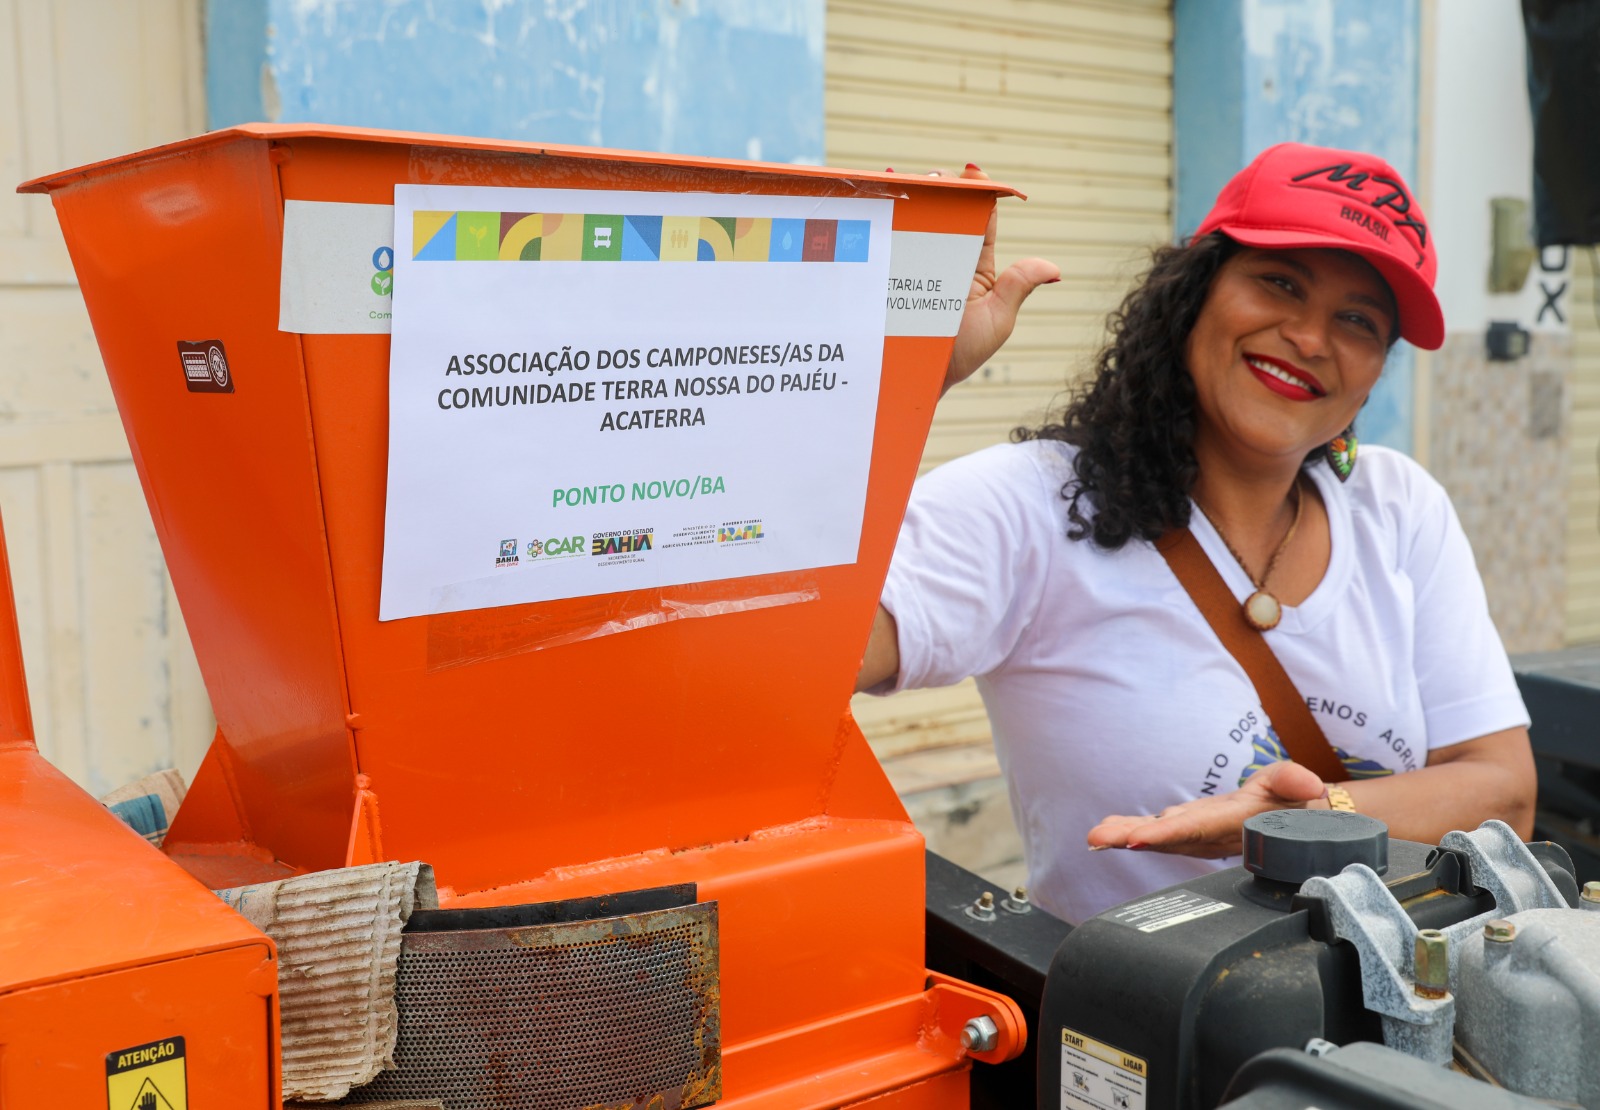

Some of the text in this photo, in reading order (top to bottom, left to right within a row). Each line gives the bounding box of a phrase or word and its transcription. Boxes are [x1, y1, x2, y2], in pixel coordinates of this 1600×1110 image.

[1340, 206, 1391, 242] BRASIL
[927, 280, 942, 292] DE
[445, 343, 845, 377] ASSOCIAÇÃO DOS CAMPONESES/AS DA
[437, 381, 596, 411] COMUNIDADE
[602, 379, 668, 402] TERRA
[674, 376, 741, 398] NOSSA
[747, 374, 775, 395] DO
[780, 368, 837, 393] PAJÉU
[599, 407, 707, 433] ACATERRA
[552, 476, 726, 508] PONTO NOVO/BA
[544, 535, 586, 556] CAR
[592, 530, 622, 539] GOVERNO
[632, 527, 654, 535] ESTADO
[592, 534, 653, 557] BAHIA
[717, 524, 765, 543] BRASIL
[495, 556, 519, 564] BAHIA
[1199, 753, 1229, 796] NTO
[1229, 711, 1258, 743] DOS
[117, 1042, 175, 1069] ATENÇÃO
[1064, 1033, 1143, 1073] START LIGAR
